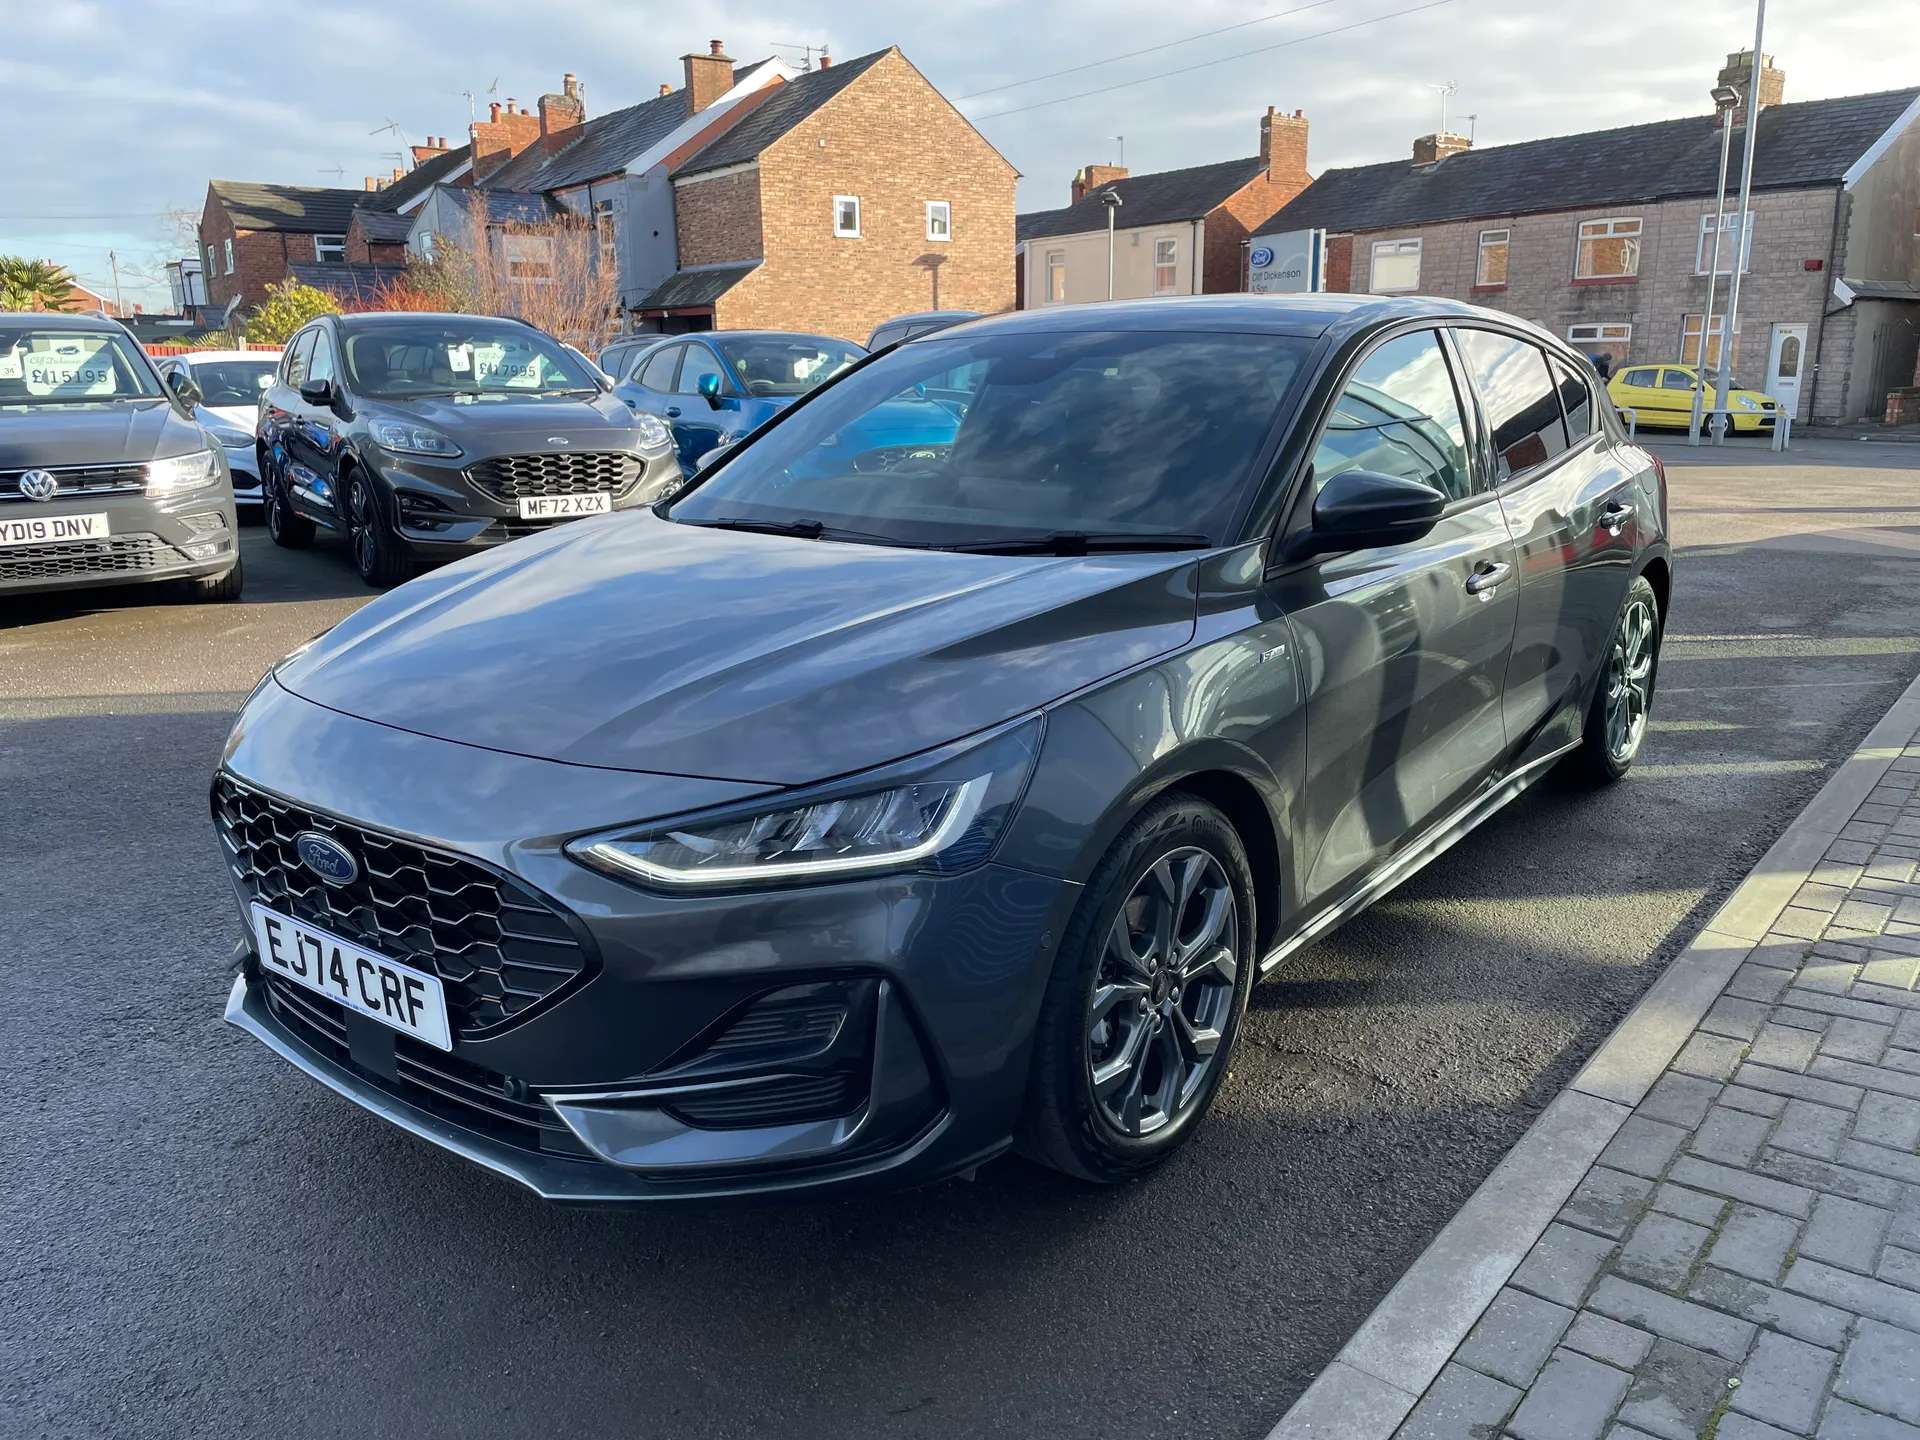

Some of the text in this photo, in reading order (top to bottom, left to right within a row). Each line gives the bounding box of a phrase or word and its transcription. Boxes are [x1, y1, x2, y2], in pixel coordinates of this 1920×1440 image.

[32, 369, 107, 384] £15195
[528, 496, 604, 515] MF72 XZX
[0, 518, 92, 541] YD19 DNV
[307, 843, 339, 874] Ford
[264, 916, 425, 1028] EJ74 CRF
